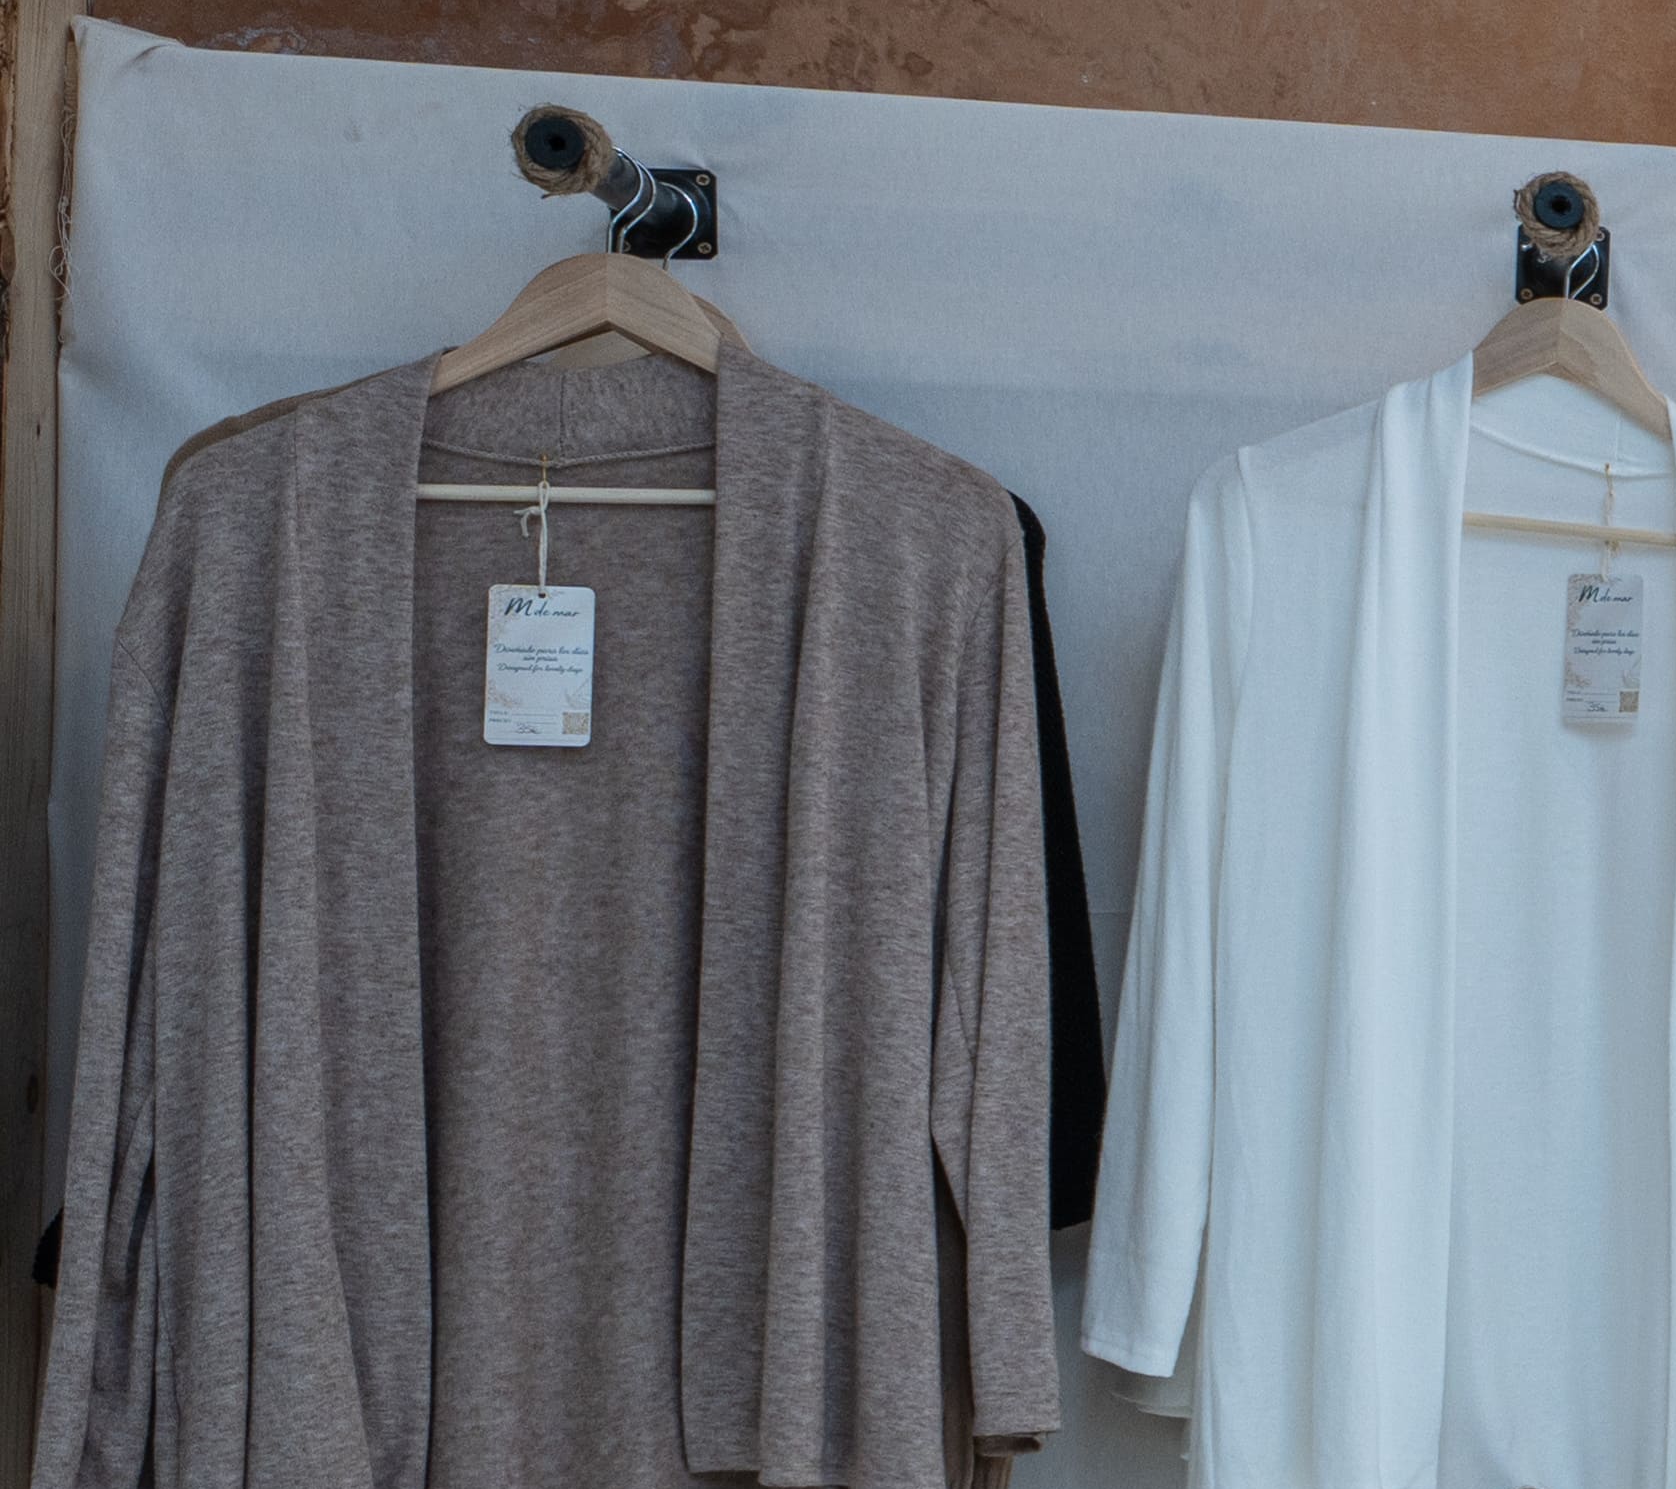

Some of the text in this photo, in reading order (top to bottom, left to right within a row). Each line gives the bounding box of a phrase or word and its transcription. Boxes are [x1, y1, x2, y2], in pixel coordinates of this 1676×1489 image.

[1578, 585, 1599, 602] M
[1600, 588, 1610, 603] de
[504, 597, 533, 616] M
[534, 601, 550, 617] de
